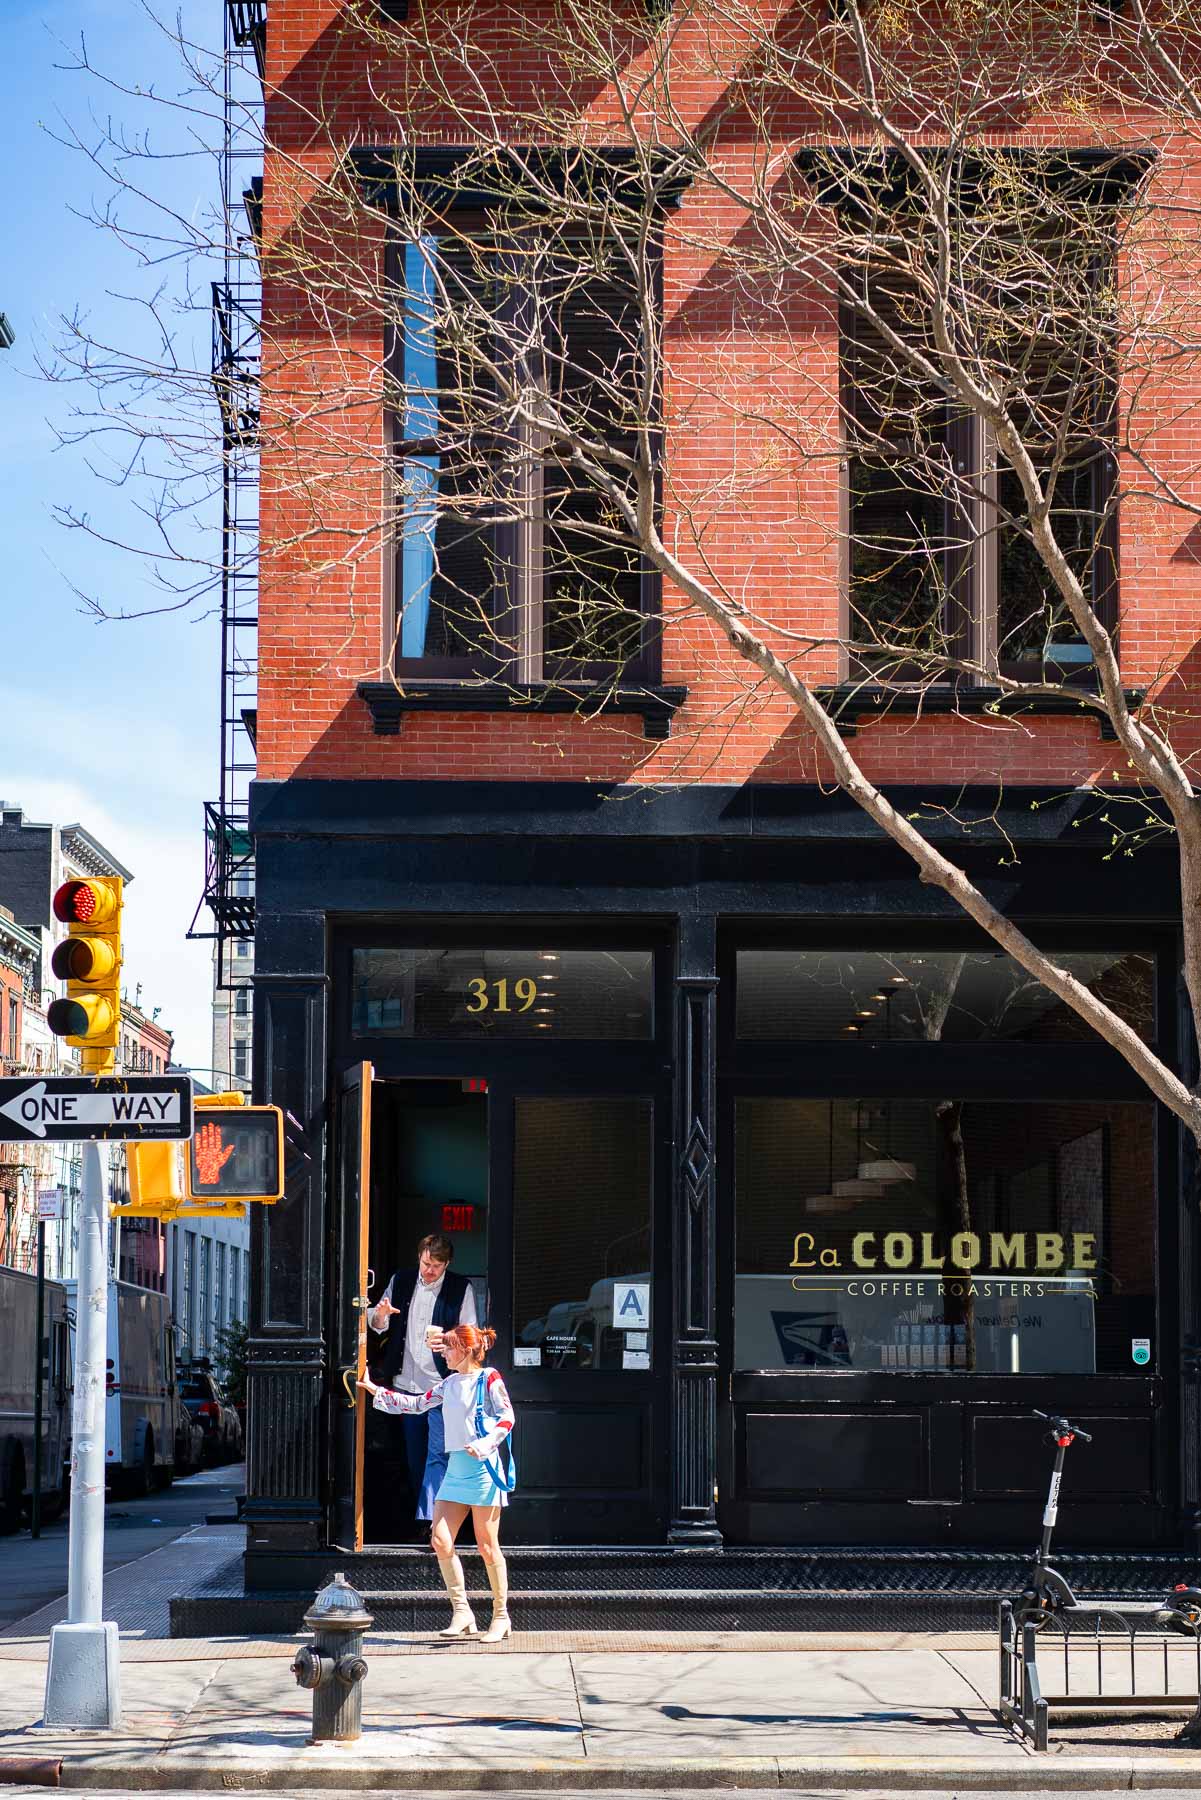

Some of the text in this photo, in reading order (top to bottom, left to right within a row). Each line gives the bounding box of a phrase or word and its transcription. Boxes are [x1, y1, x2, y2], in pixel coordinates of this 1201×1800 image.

[466, 978, 537, 1012] 319
[21, 1096, 173, 1121] ONE WAY
[442, 1205, 473, 1231] EXIT
[789, 1231, 1097, 1269] La COLOMBE
[619, 1289, 643, 1316] A
[847, 1282, 1046, 1297] COFFEE ROASTERS
